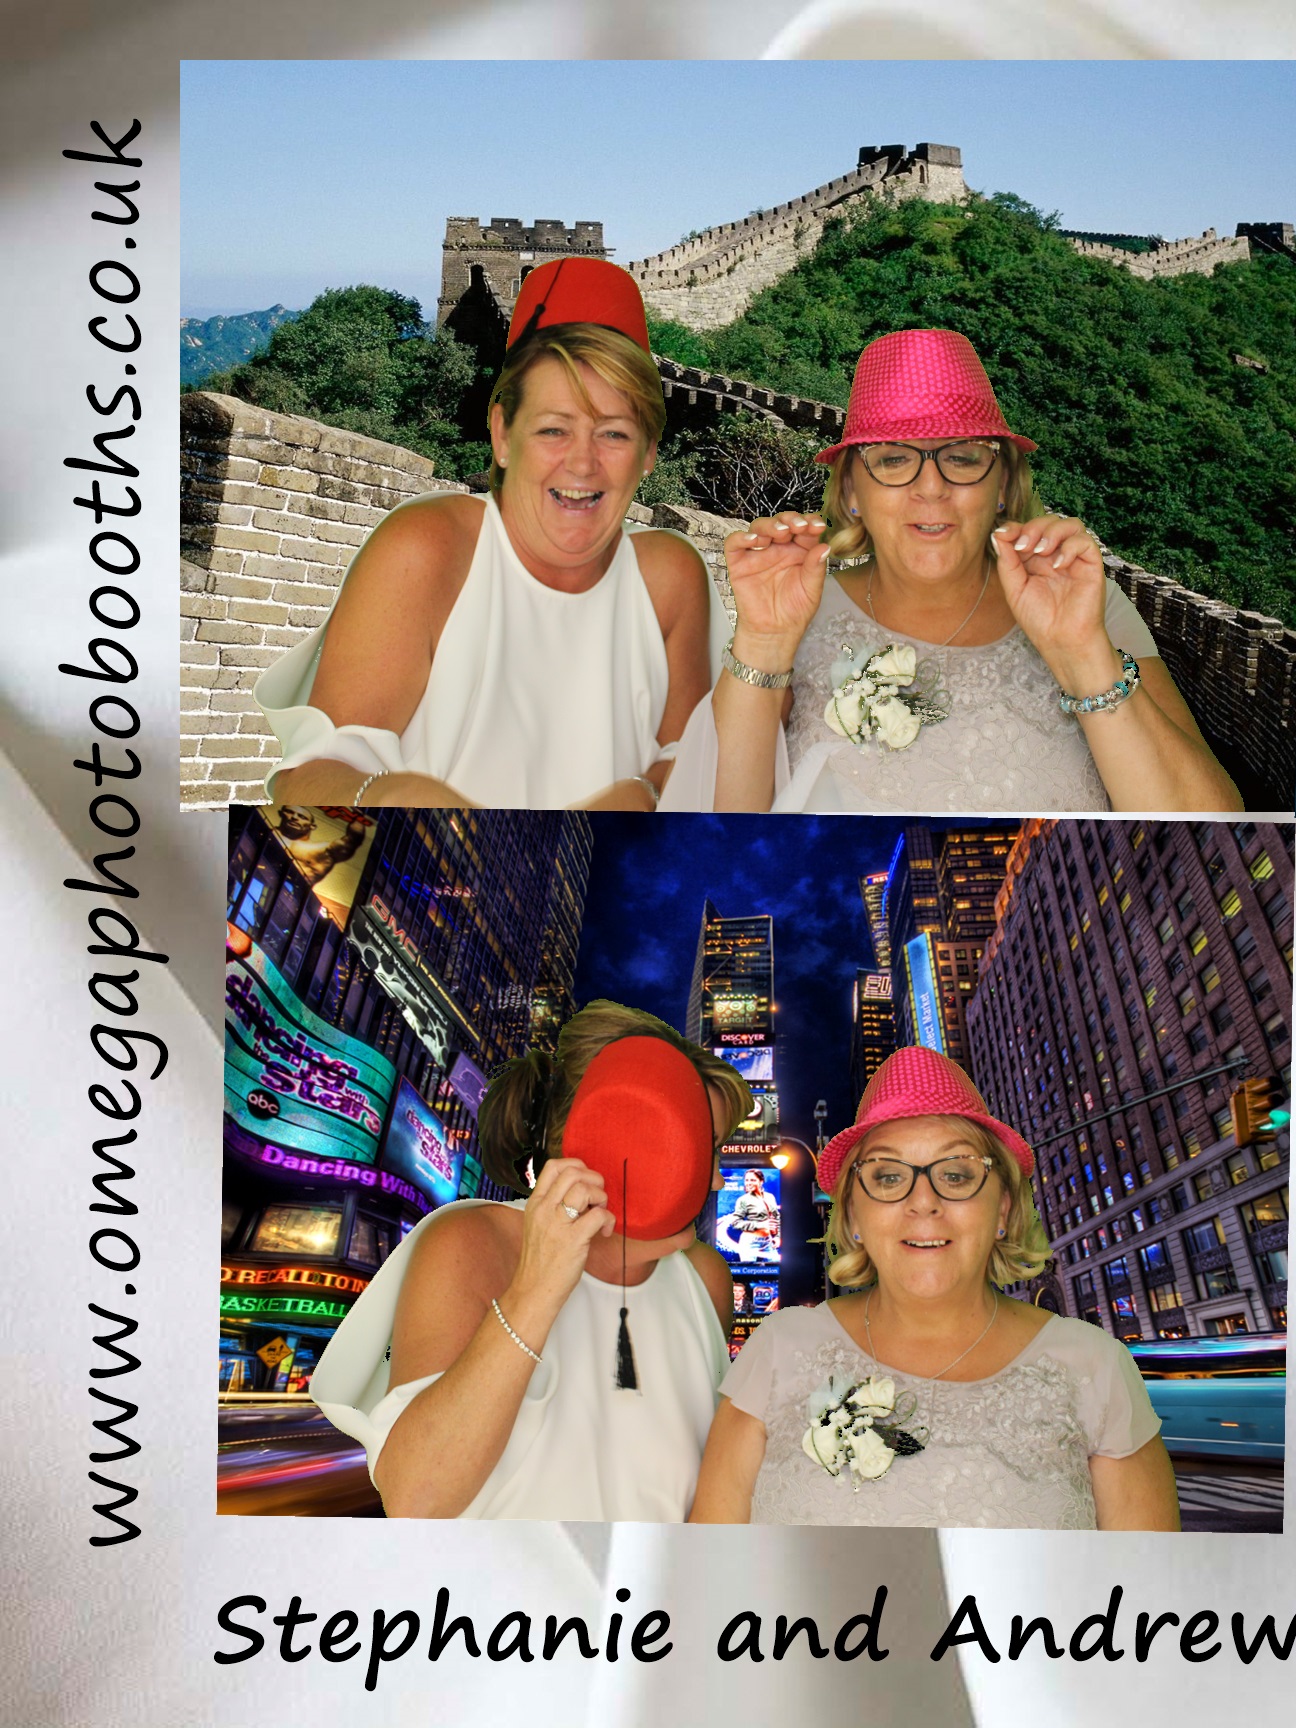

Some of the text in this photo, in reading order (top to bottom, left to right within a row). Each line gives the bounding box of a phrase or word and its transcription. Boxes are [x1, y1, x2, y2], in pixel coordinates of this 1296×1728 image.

[372, 894, 418, 962] GMC
[920, 991, 932, 1025] Market
[225, 974, 359, 1090] dancing
[721, 1033, 765, 1041] DISCOVER
[248, 1093, 279, 1114] abc
[721, 1144, 778, 1153] CHEVROLET
[261, 1144, 378, 1187] Dancing
[380, 1171, 420, 1200] With
[320, 1272, 350, 1290] TO
